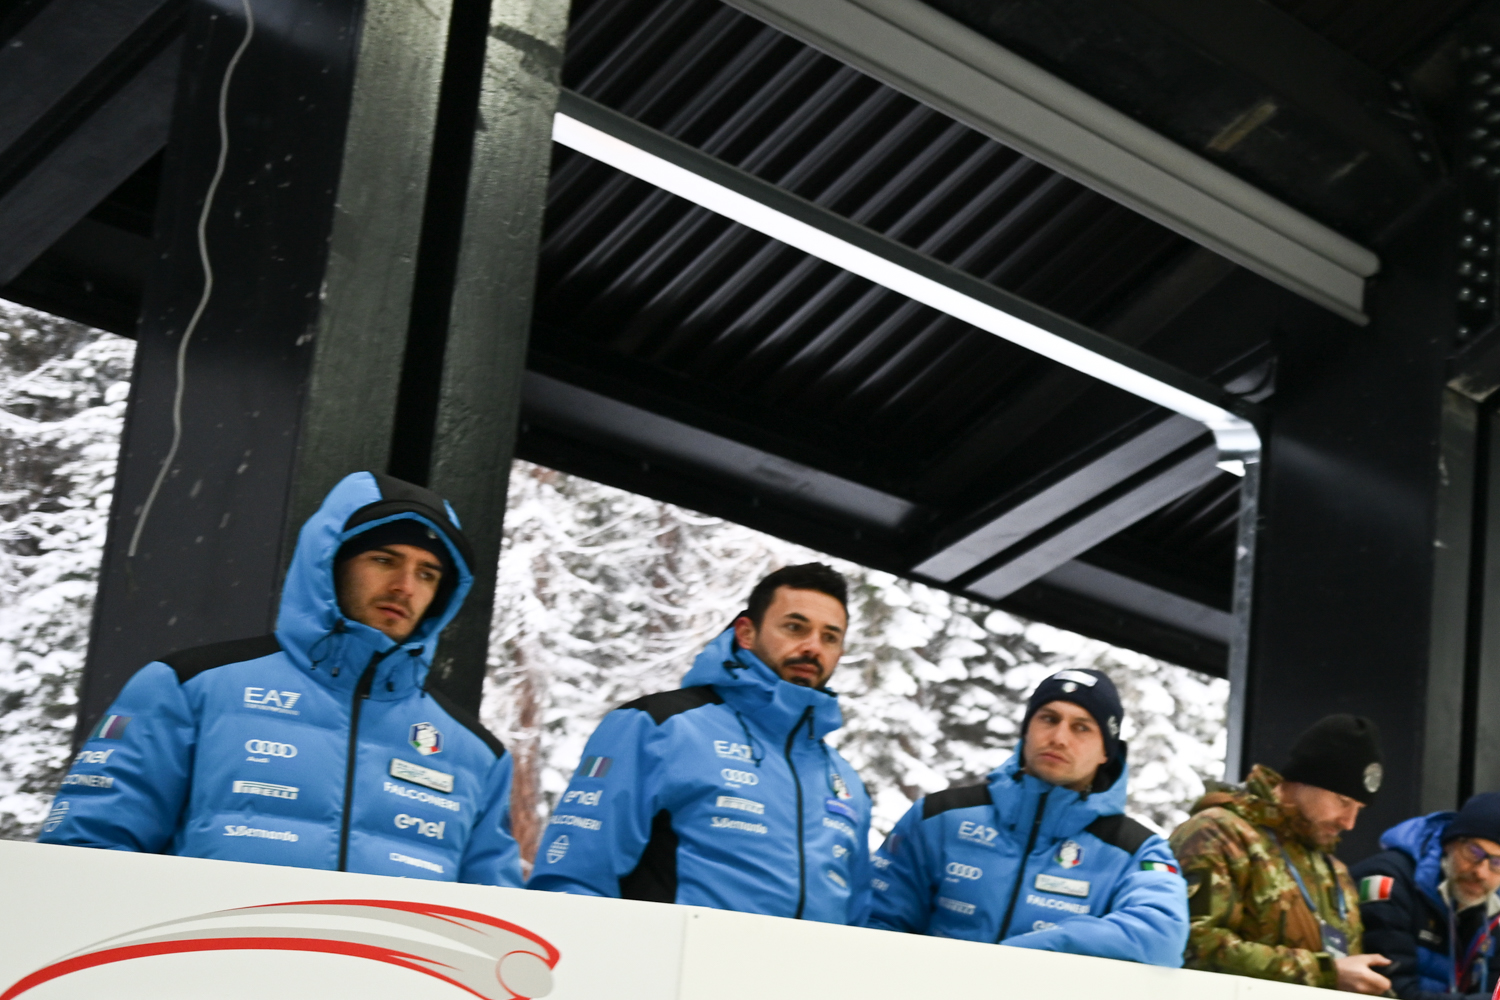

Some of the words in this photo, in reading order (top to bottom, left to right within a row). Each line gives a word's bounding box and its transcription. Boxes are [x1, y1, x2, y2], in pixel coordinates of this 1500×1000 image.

[244, 687, 301, 709] EA7
[232, 780, 299, 800] PIRELLI
[383, 782, 460, 811] FALCONERI
[394, 813, 446, 839] enel
[958, 821, 999, 842] EA7
